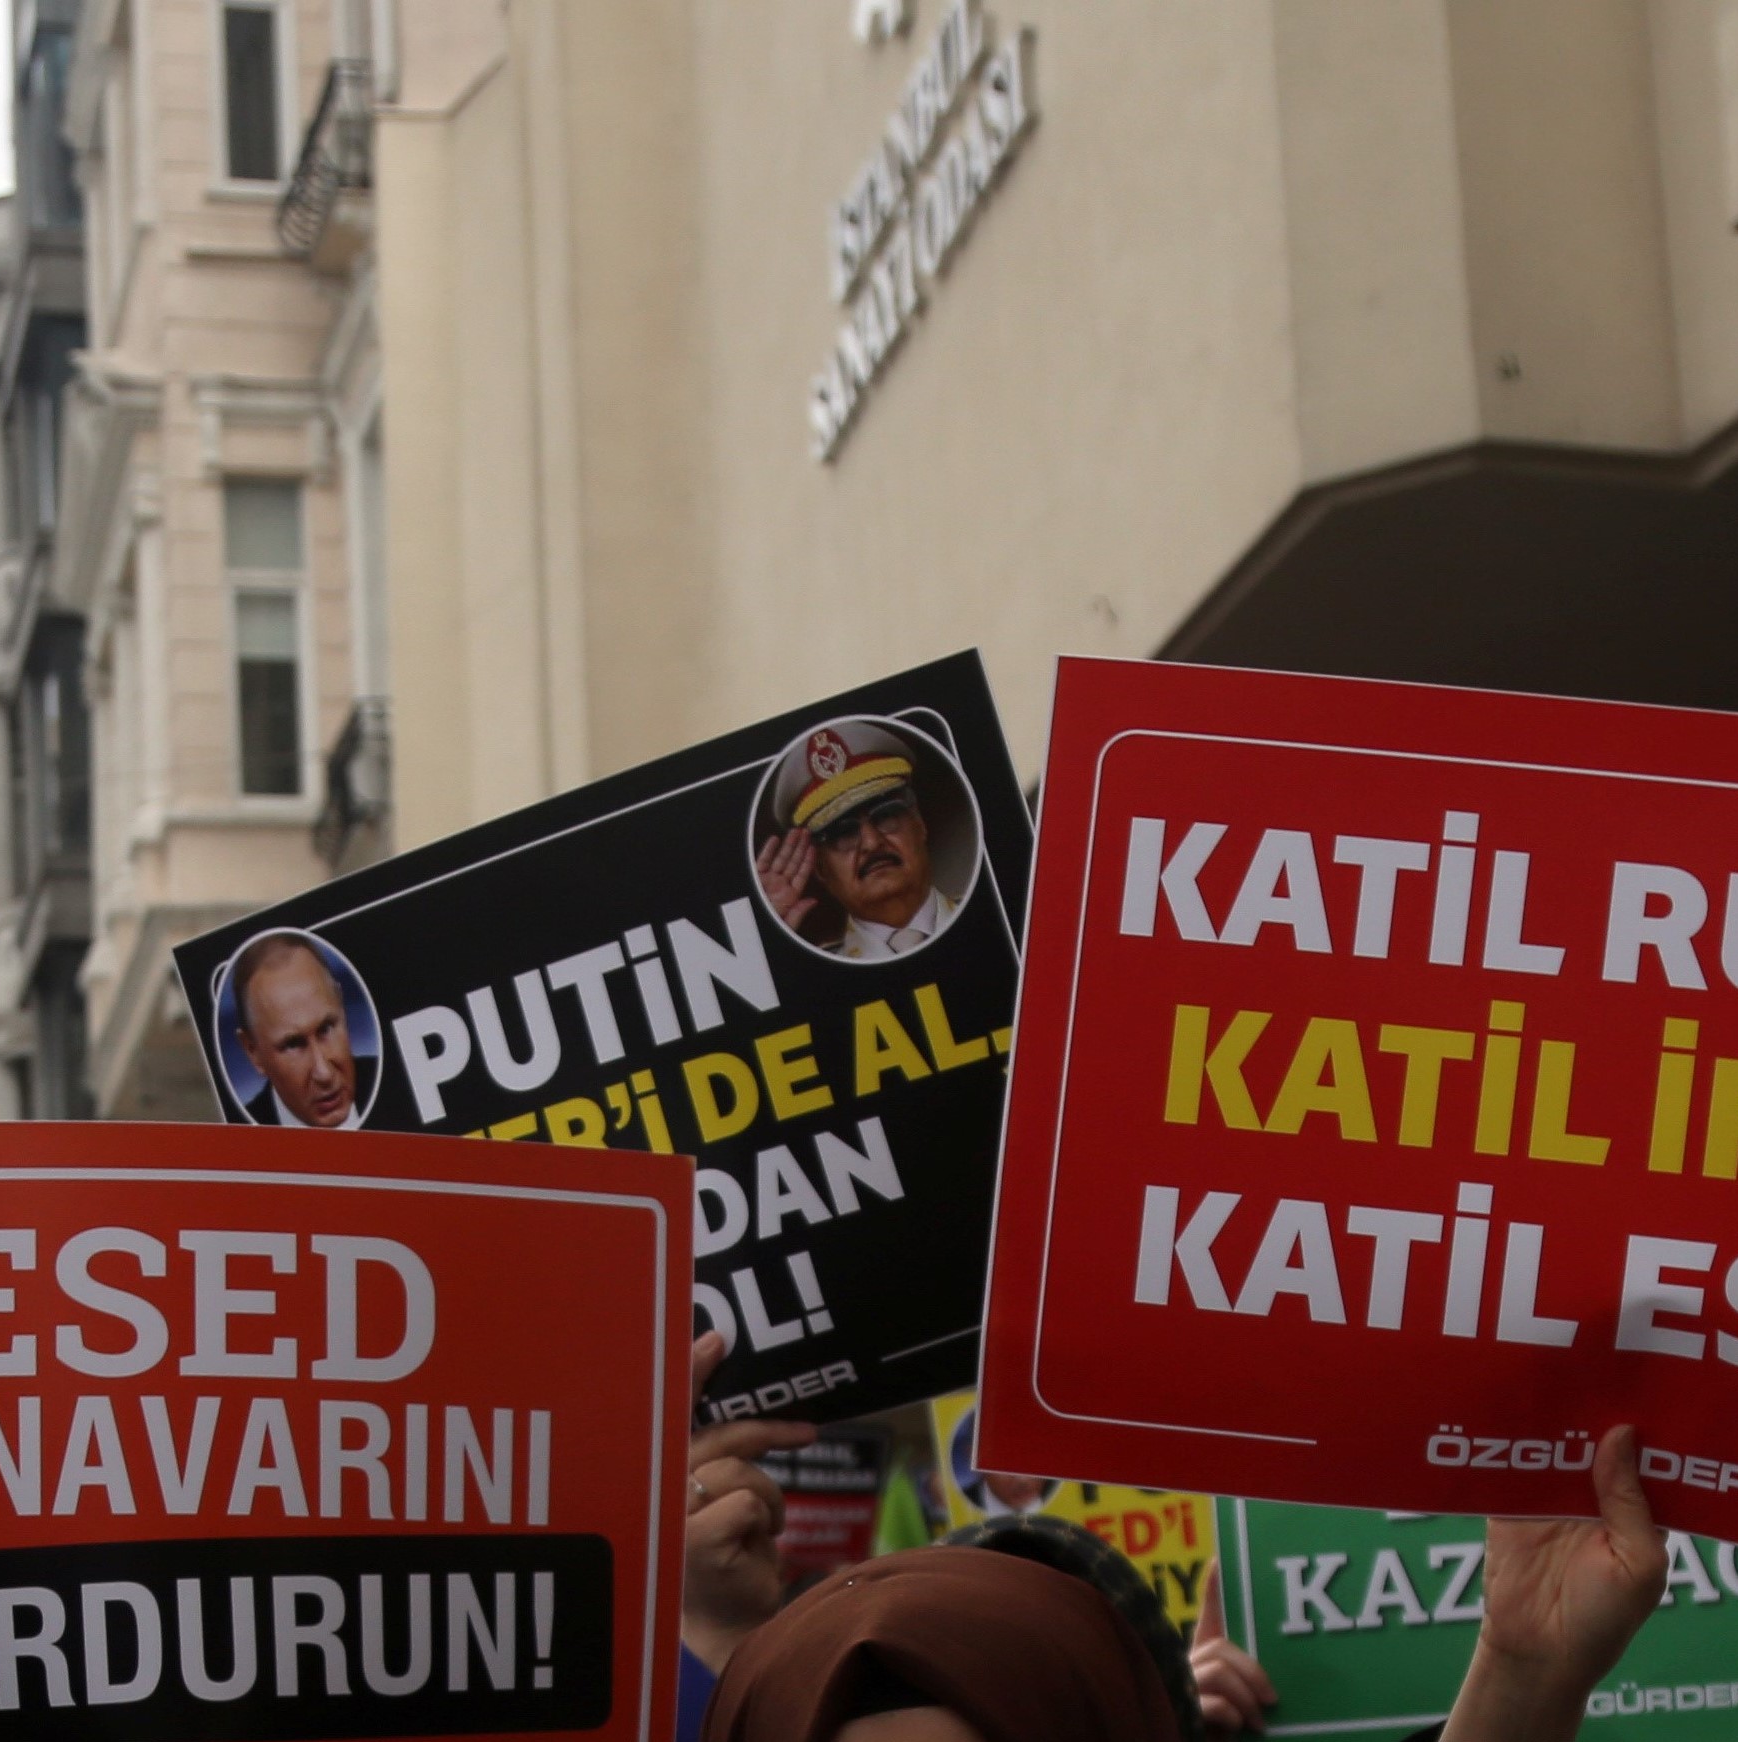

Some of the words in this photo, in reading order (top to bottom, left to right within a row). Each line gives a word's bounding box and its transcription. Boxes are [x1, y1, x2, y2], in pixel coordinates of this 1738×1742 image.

[1120, 811, 1565, 975] KATİL
[683, 1024, 833, 1142] DE
[1164, 1000, 1610, 1165] KATİL
[1135, 1182, 1577, 1346] KATİL
